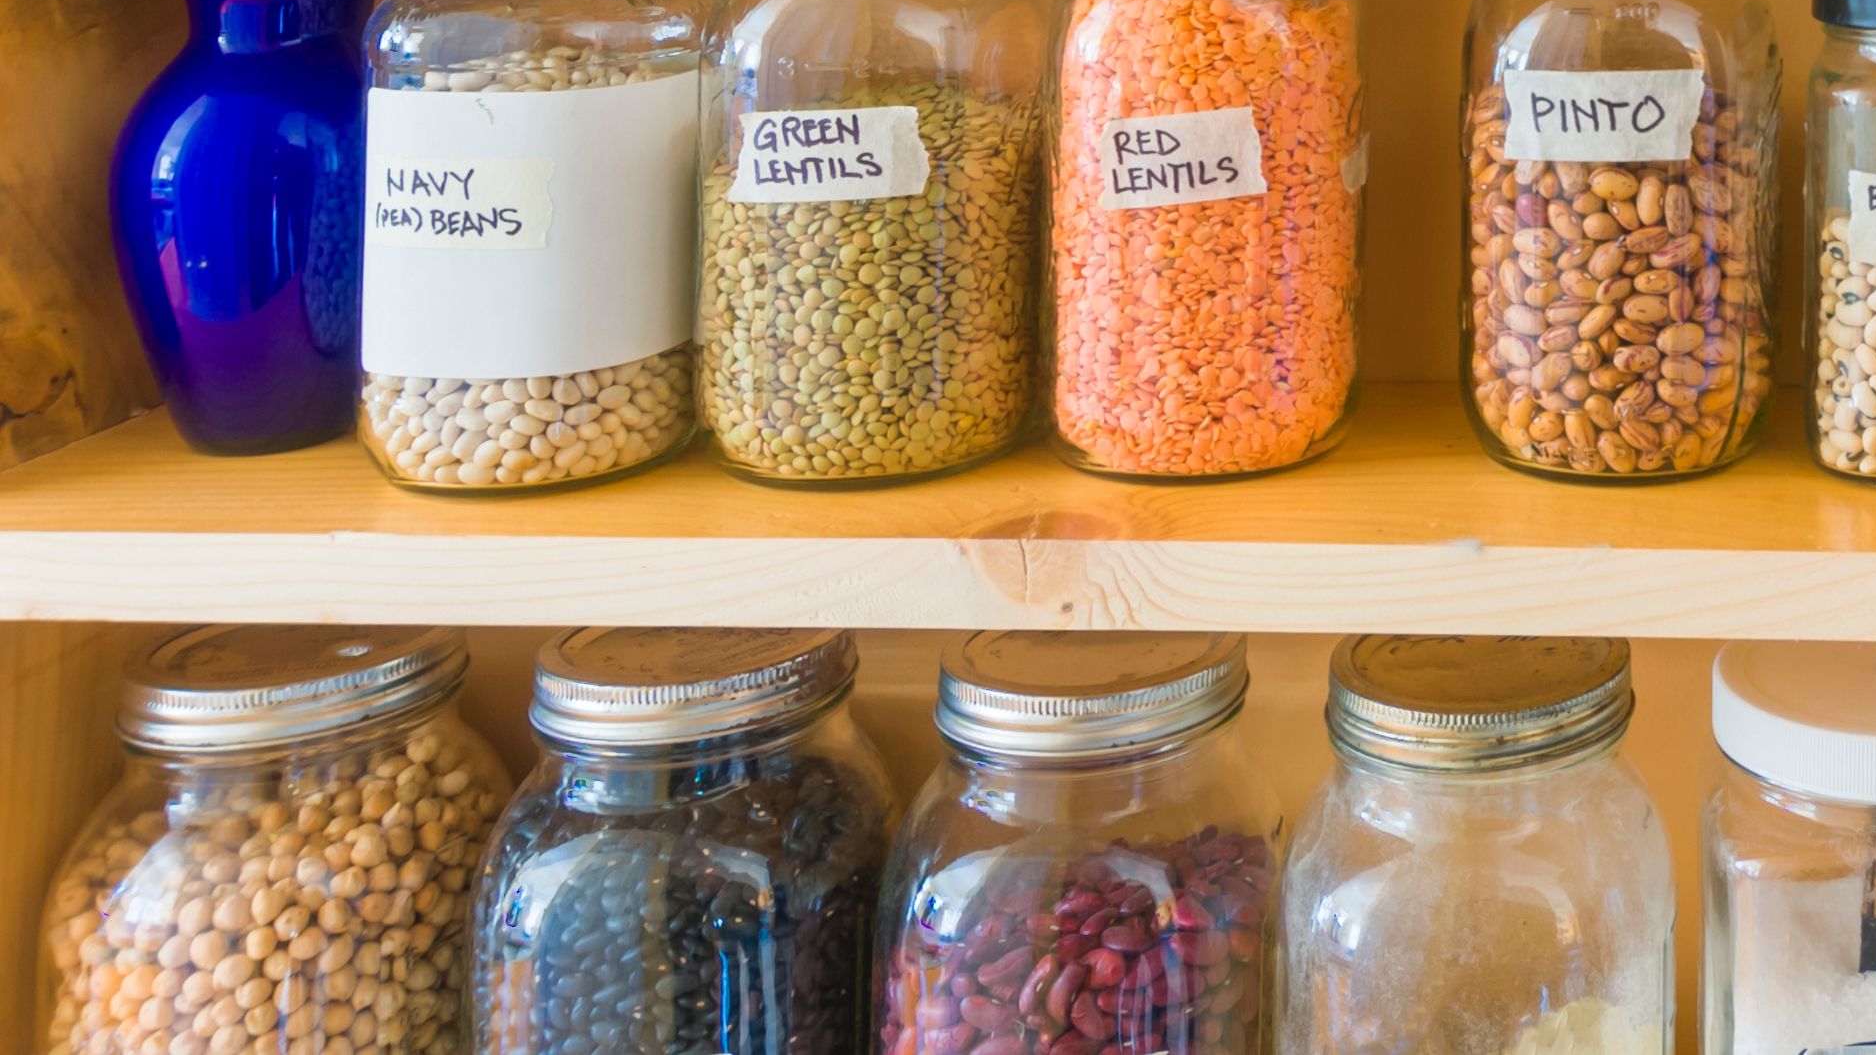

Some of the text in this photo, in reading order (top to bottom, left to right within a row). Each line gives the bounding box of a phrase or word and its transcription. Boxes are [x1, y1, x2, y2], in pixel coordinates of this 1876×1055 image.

[1531, 93, 1665, 133] PINTO
[754, 113, 861, 150] GREEN
[1113, 130, 1182, 158] RED
[387, 169, 474, 200] NAVY
[754, 152, 883, 185] LENTILS
[1112, 157, 1240, 195] LENTILS
[376, 203, 522, 237] (PEA) BEANS
